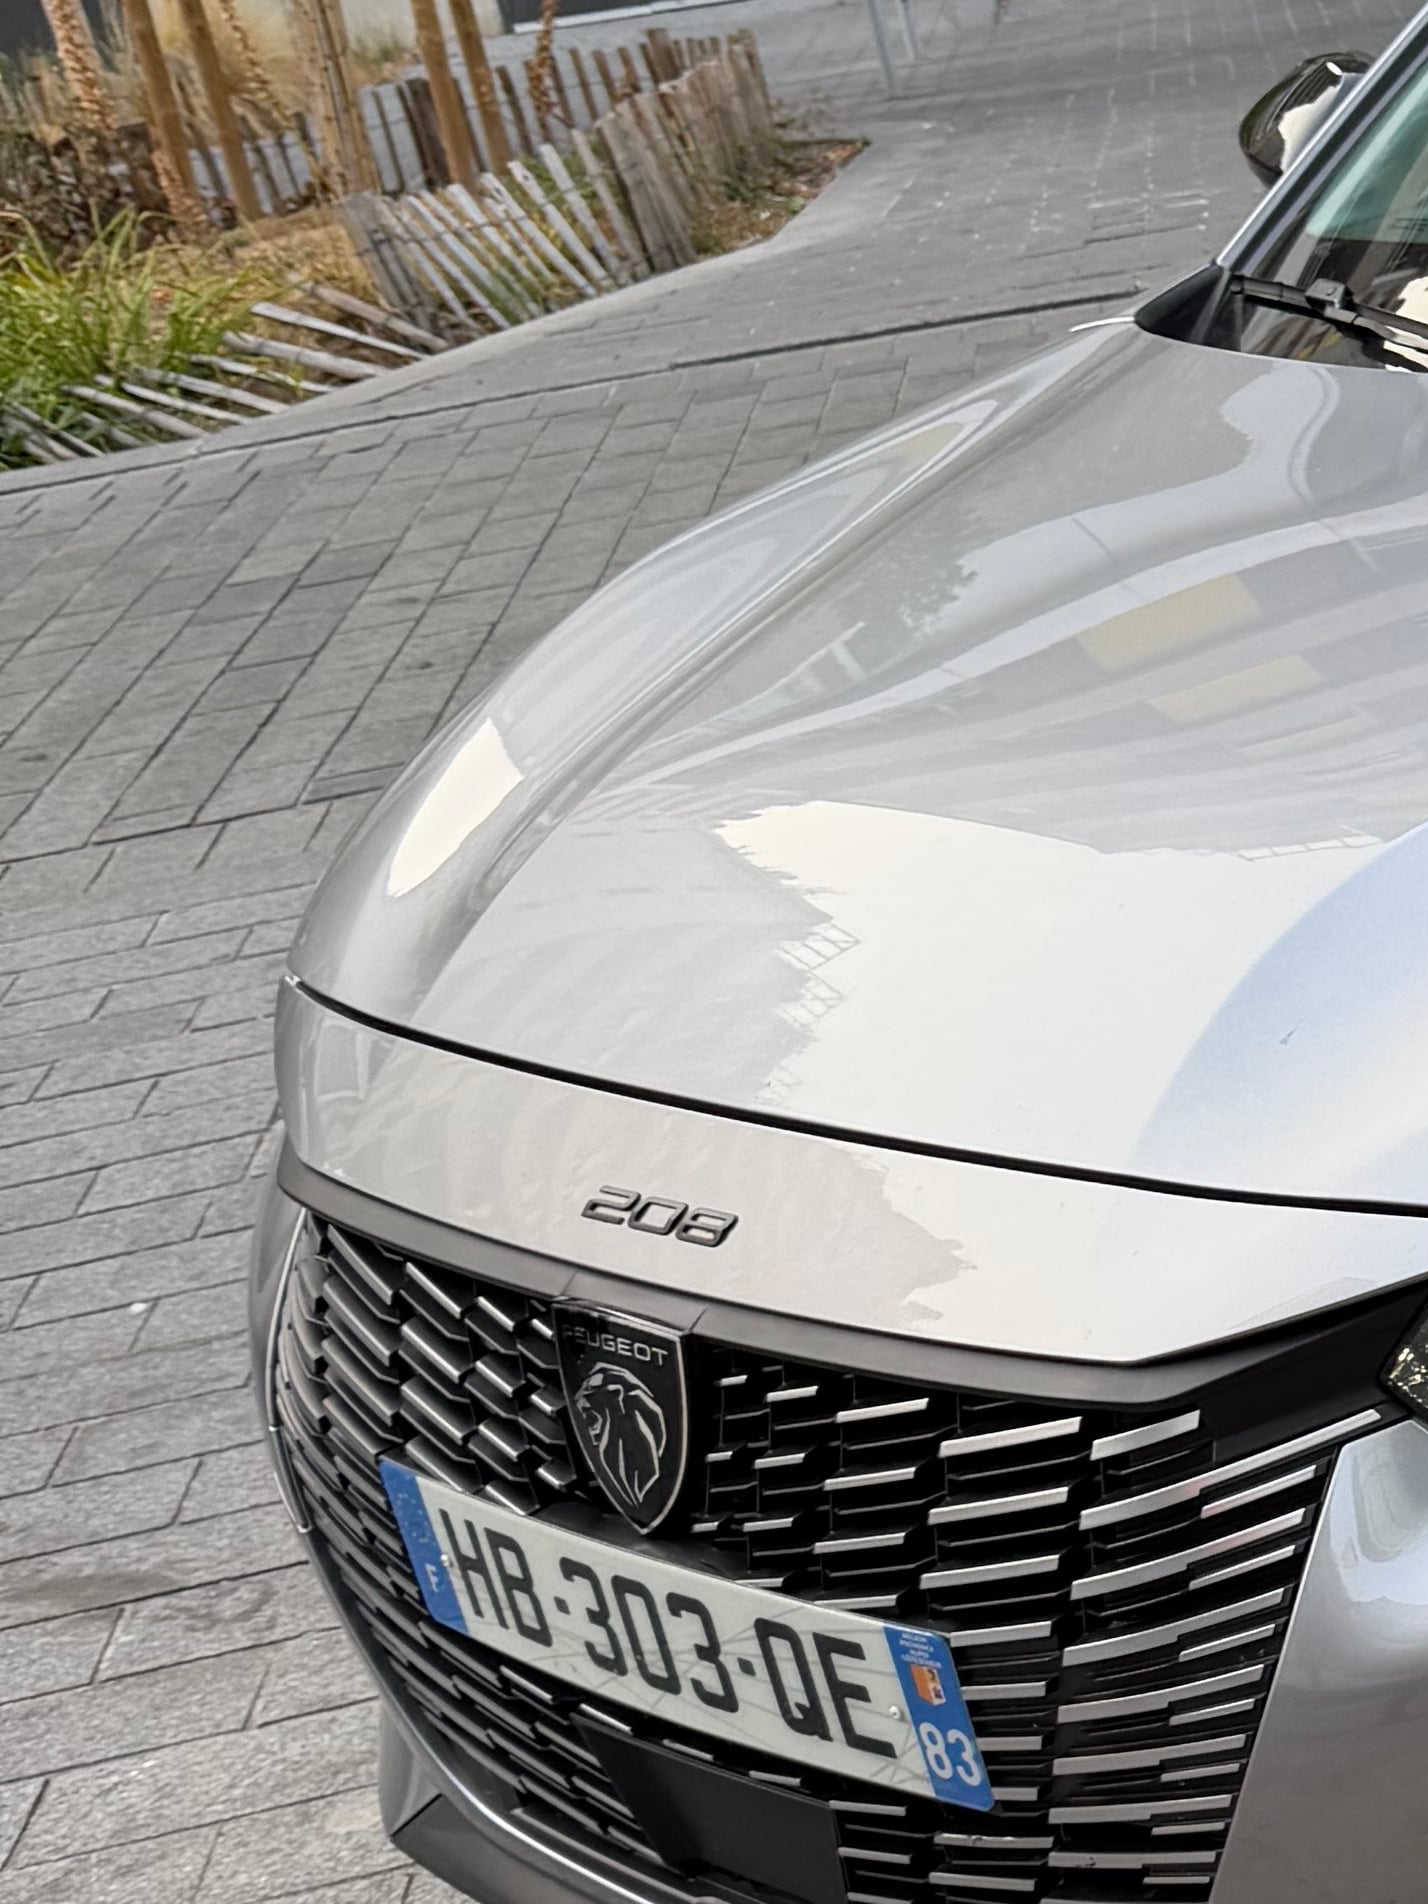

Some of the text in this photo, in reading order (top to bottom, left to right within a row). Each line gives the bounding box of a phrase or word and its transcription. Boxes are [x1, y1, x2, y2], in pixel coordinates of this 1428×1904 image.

[580, 1184, 740, 1248] 208
[563, 1323, 669, 1366] PEUGEOT
[437, 1507, 899, 1760] HB-303-QE
[917, 1720, 982, 1788] 83
